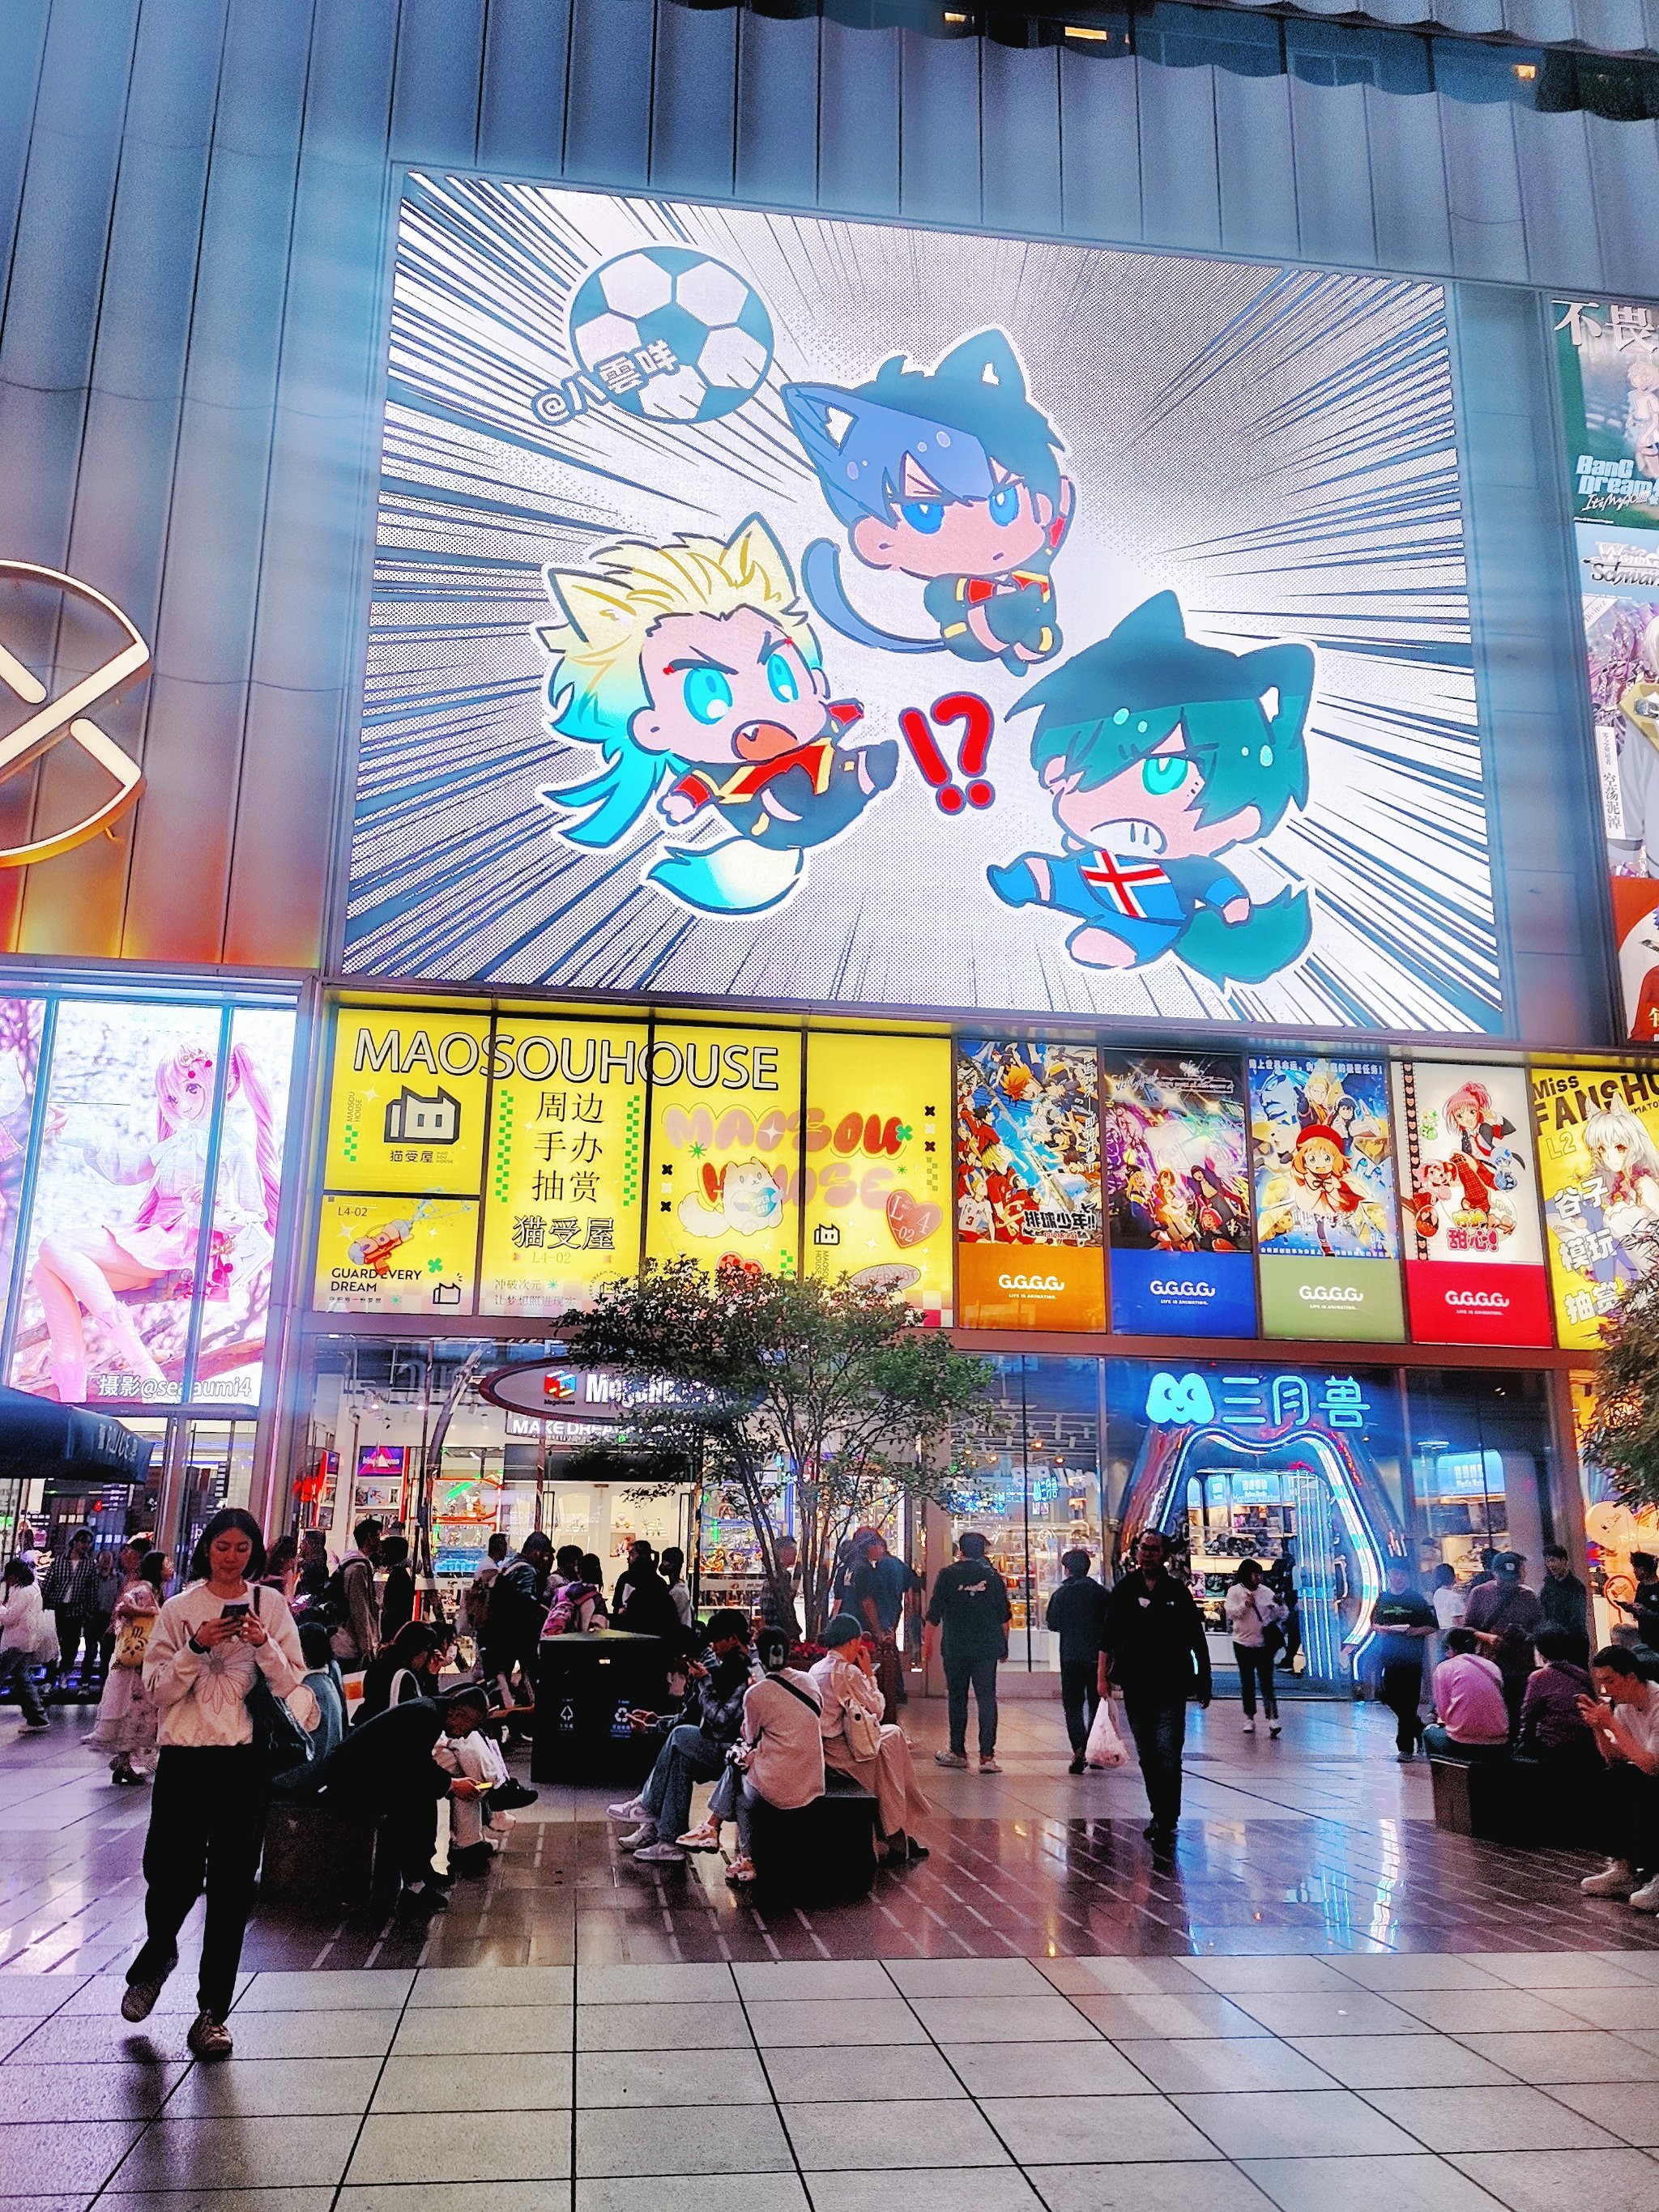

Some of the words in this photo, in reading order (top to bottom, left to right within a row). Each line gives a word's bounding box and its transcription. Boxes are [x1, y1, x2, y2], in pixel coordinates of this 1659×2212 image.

[353, 1027, 779, 1091] MAOSOUHOUSE
[1533, 1075, 1580, 1101] Miss
[347, 1091, 356, 1123] MAOSOU
[355, 1098, 363, 1123] HOUSE
[535, 1091, 605, 1123] 周边
[533, 1131, 603, 1164] 手办
[1546, 1132, 1577, 1160] L2
[532, 1169, 601, 1204] 抽赏
[1555, 1176, 1610, 1221] 谷子
[337, 1206, 368, 1217] L4-02
[511, 1214, 616, 1251] 猫受屋
[1447, 1228, 1499, 1252] 甜心!
[531, 1251, 571, 1264] L4-02
[1559, 1227, 1618, 1272] 模玩
[331, 1268, 377, 1280] GUARD
[331, 1281, 377, 1293] DREAM
[494, 1279, 542, 1291] 冲破次元
[494, 1294, 576, 1308] 让梦想照进现实
[1222, 1374, 1371, 1428] 三月兽
[513, 1419, 564, 1435] MAKE
